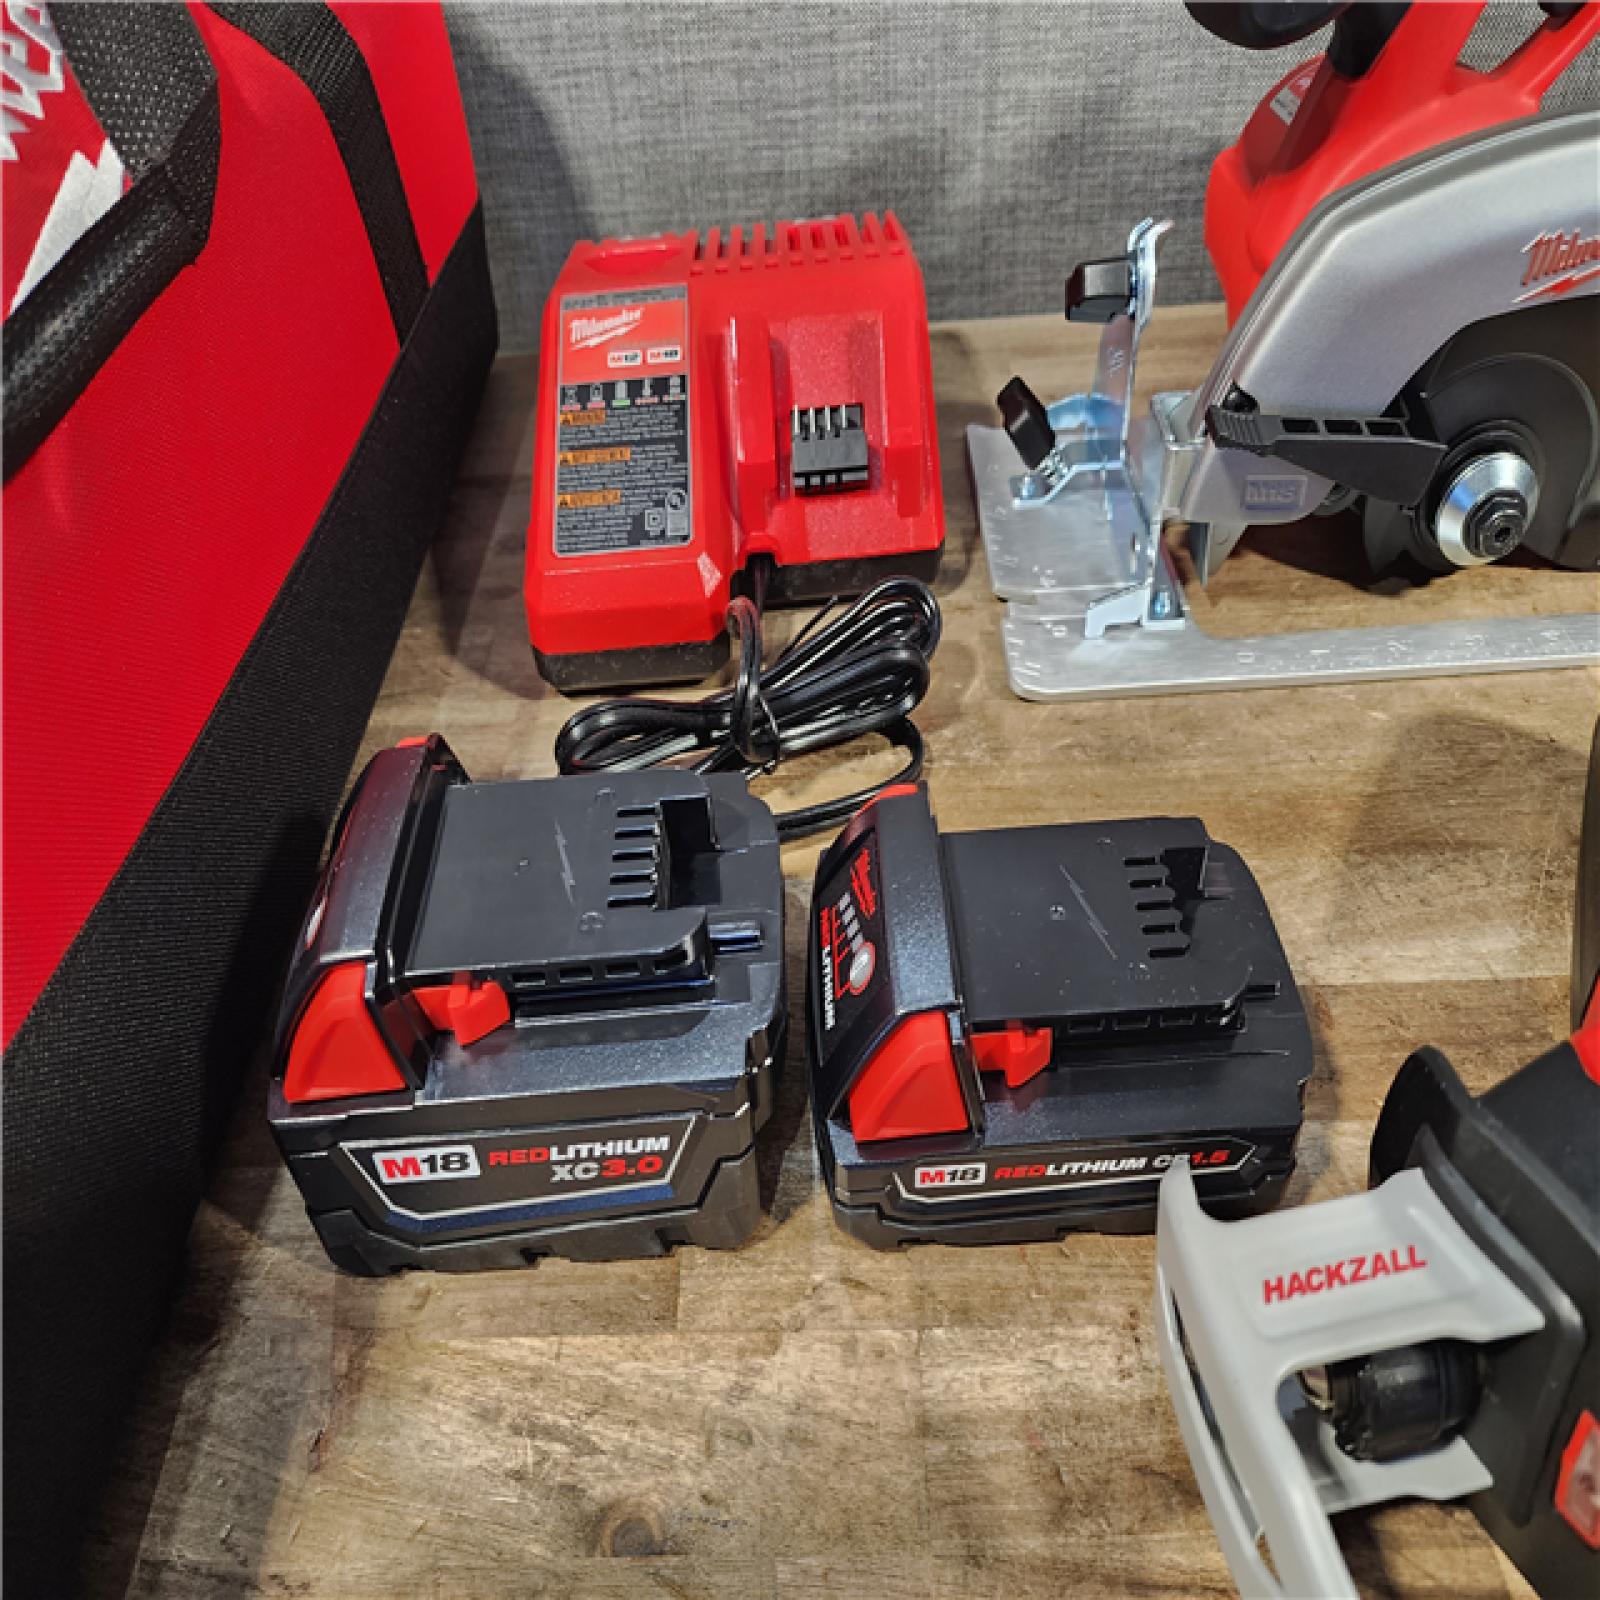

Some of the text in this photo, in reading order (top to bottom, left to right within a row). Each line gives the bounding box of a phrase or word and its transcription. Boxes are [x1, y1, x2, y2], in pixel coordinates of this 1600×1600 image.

[381, 1135, 671, 1179] M18 REDLITHIUM
[550, 1154, 663, 1183] XC3.0
[919, 1166, 981, 1184] M18
[995, 1156, 1149, 1180] REDLITHIUM
[1262, 1244, 1428, 1306] HACKZALL
